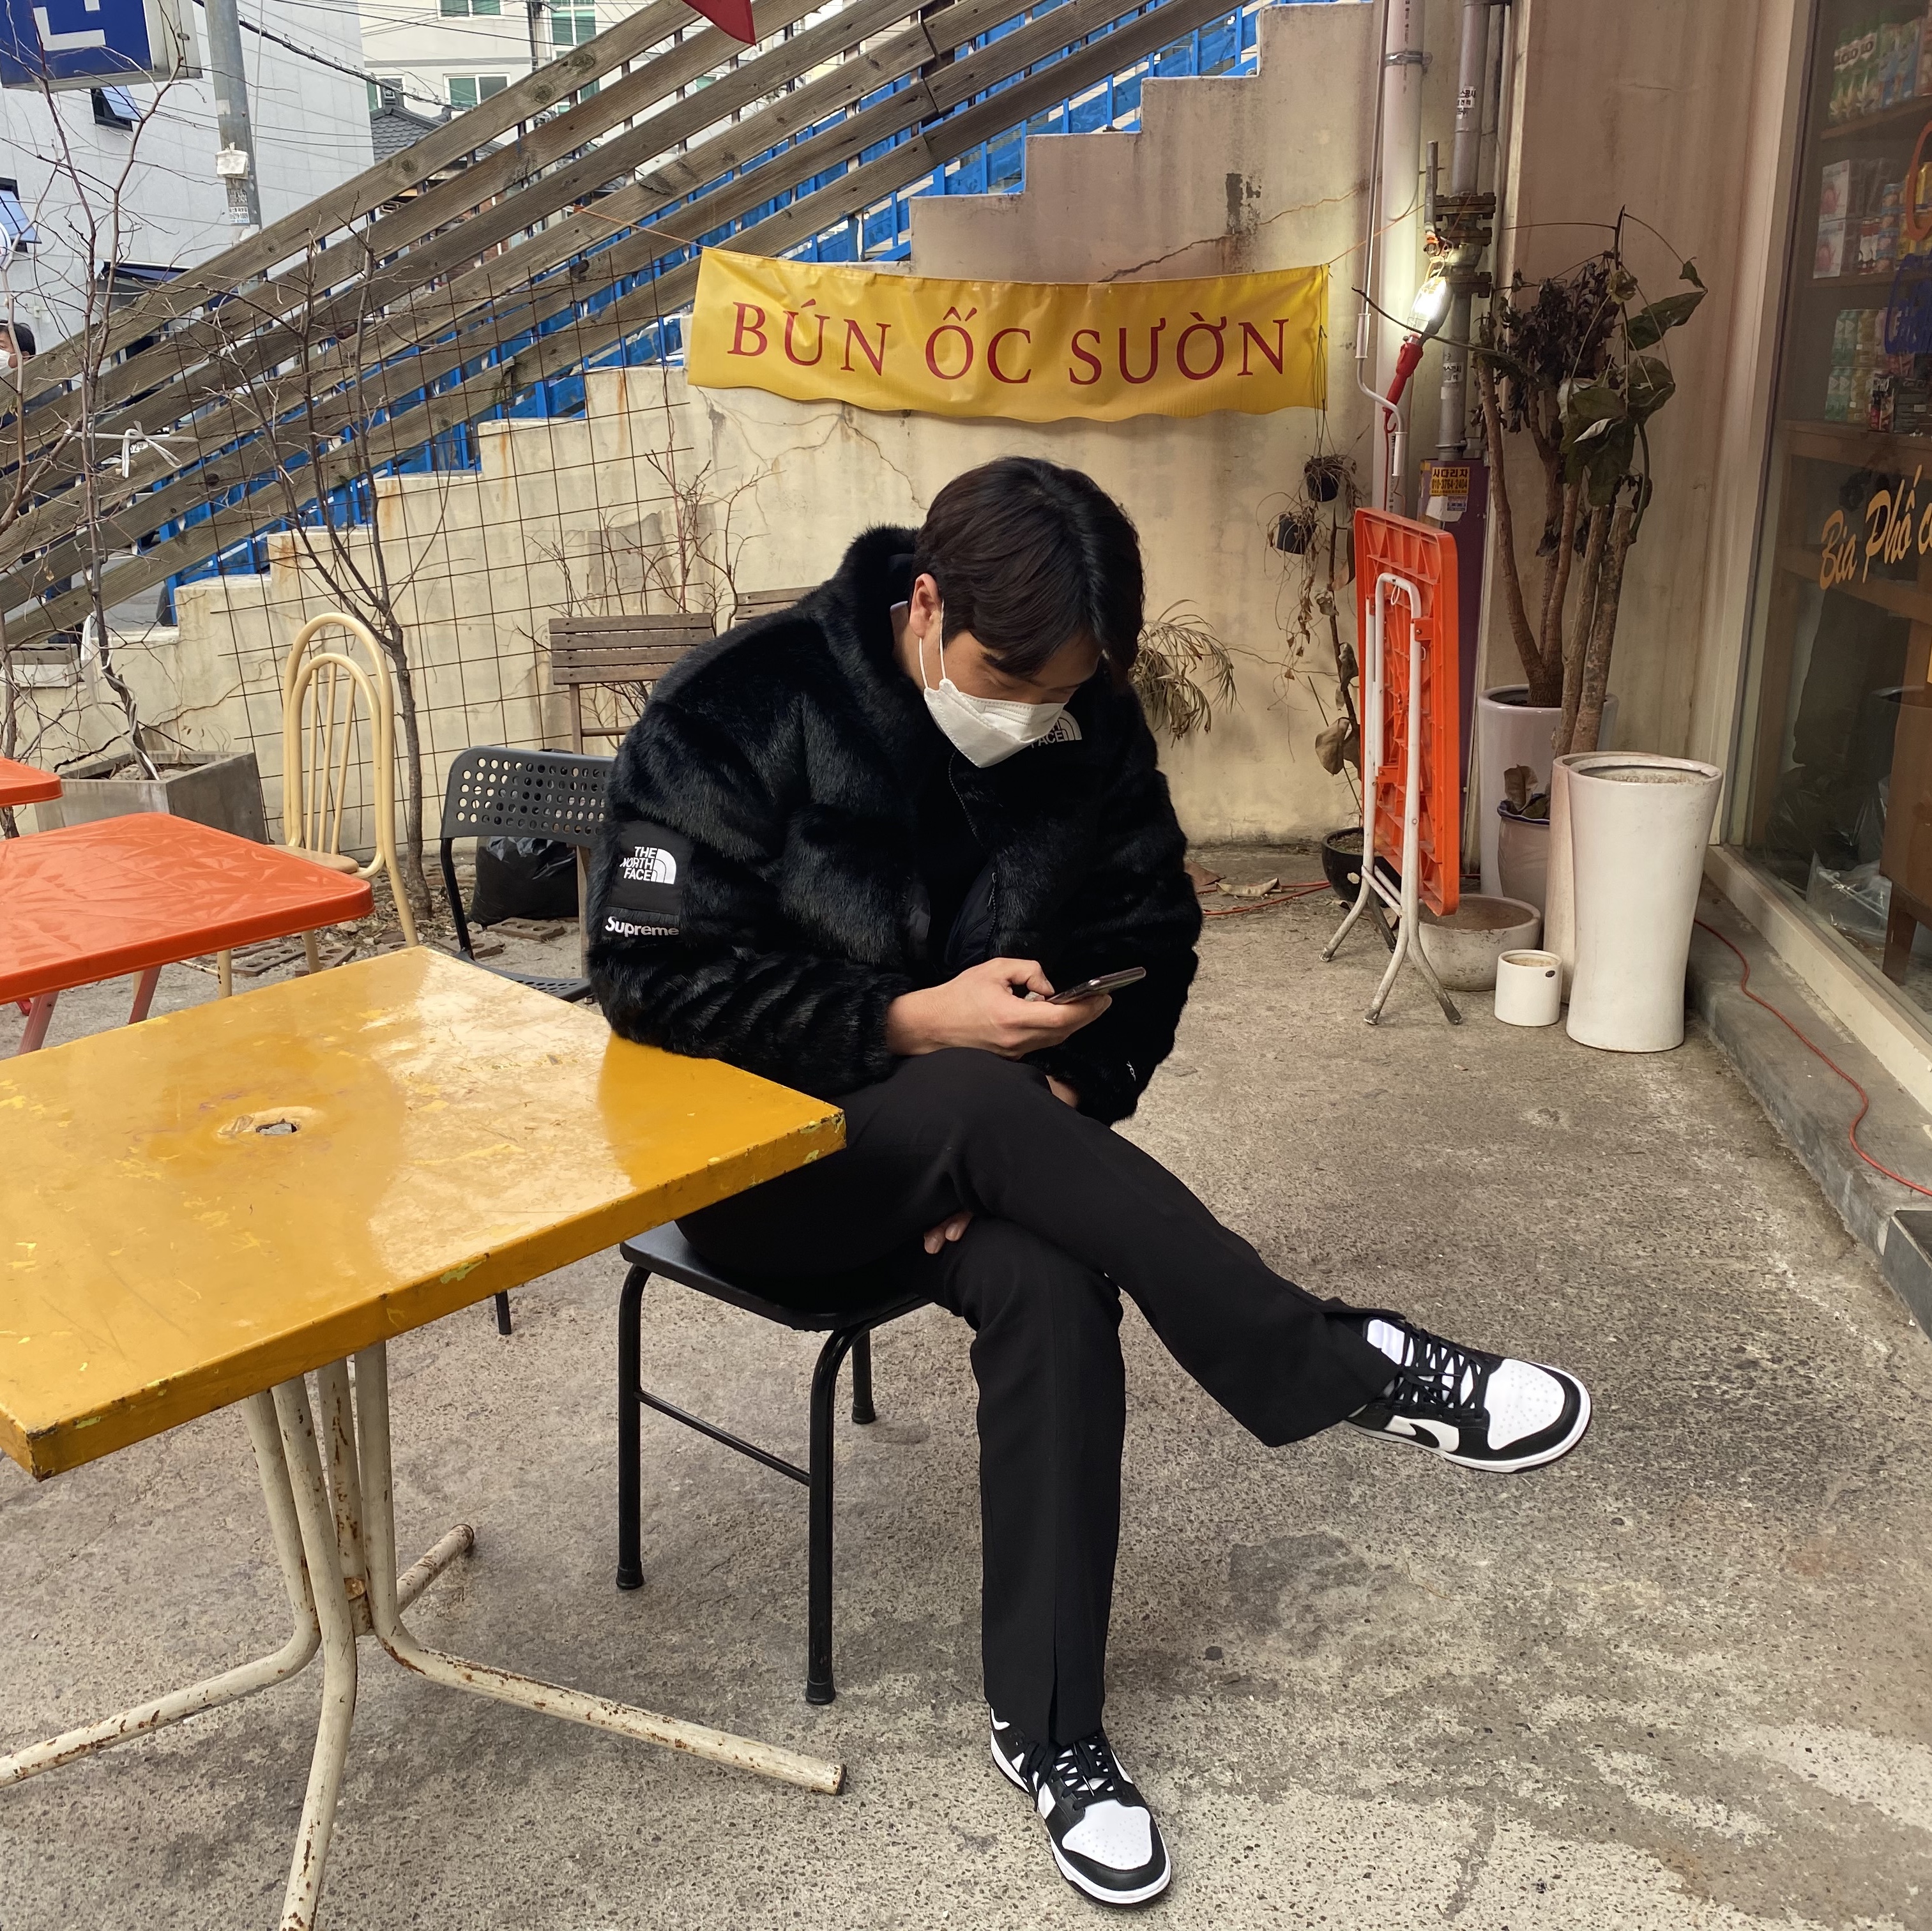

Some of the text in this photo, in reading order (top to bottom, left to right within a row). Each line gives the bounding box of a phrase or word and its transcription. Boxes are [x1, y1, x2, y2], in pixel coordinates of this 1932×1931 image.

[727, 298, 1290, 384] BÚN ỐC SƯỜN
[1433, 469, 1468, 478] 사다리차
[634, 845, 658, 859] THE
[619, 856, 655, 870] NORTH
[623, 867, 652, 882] FACE
[605, 915, 680, 937] Supreme
